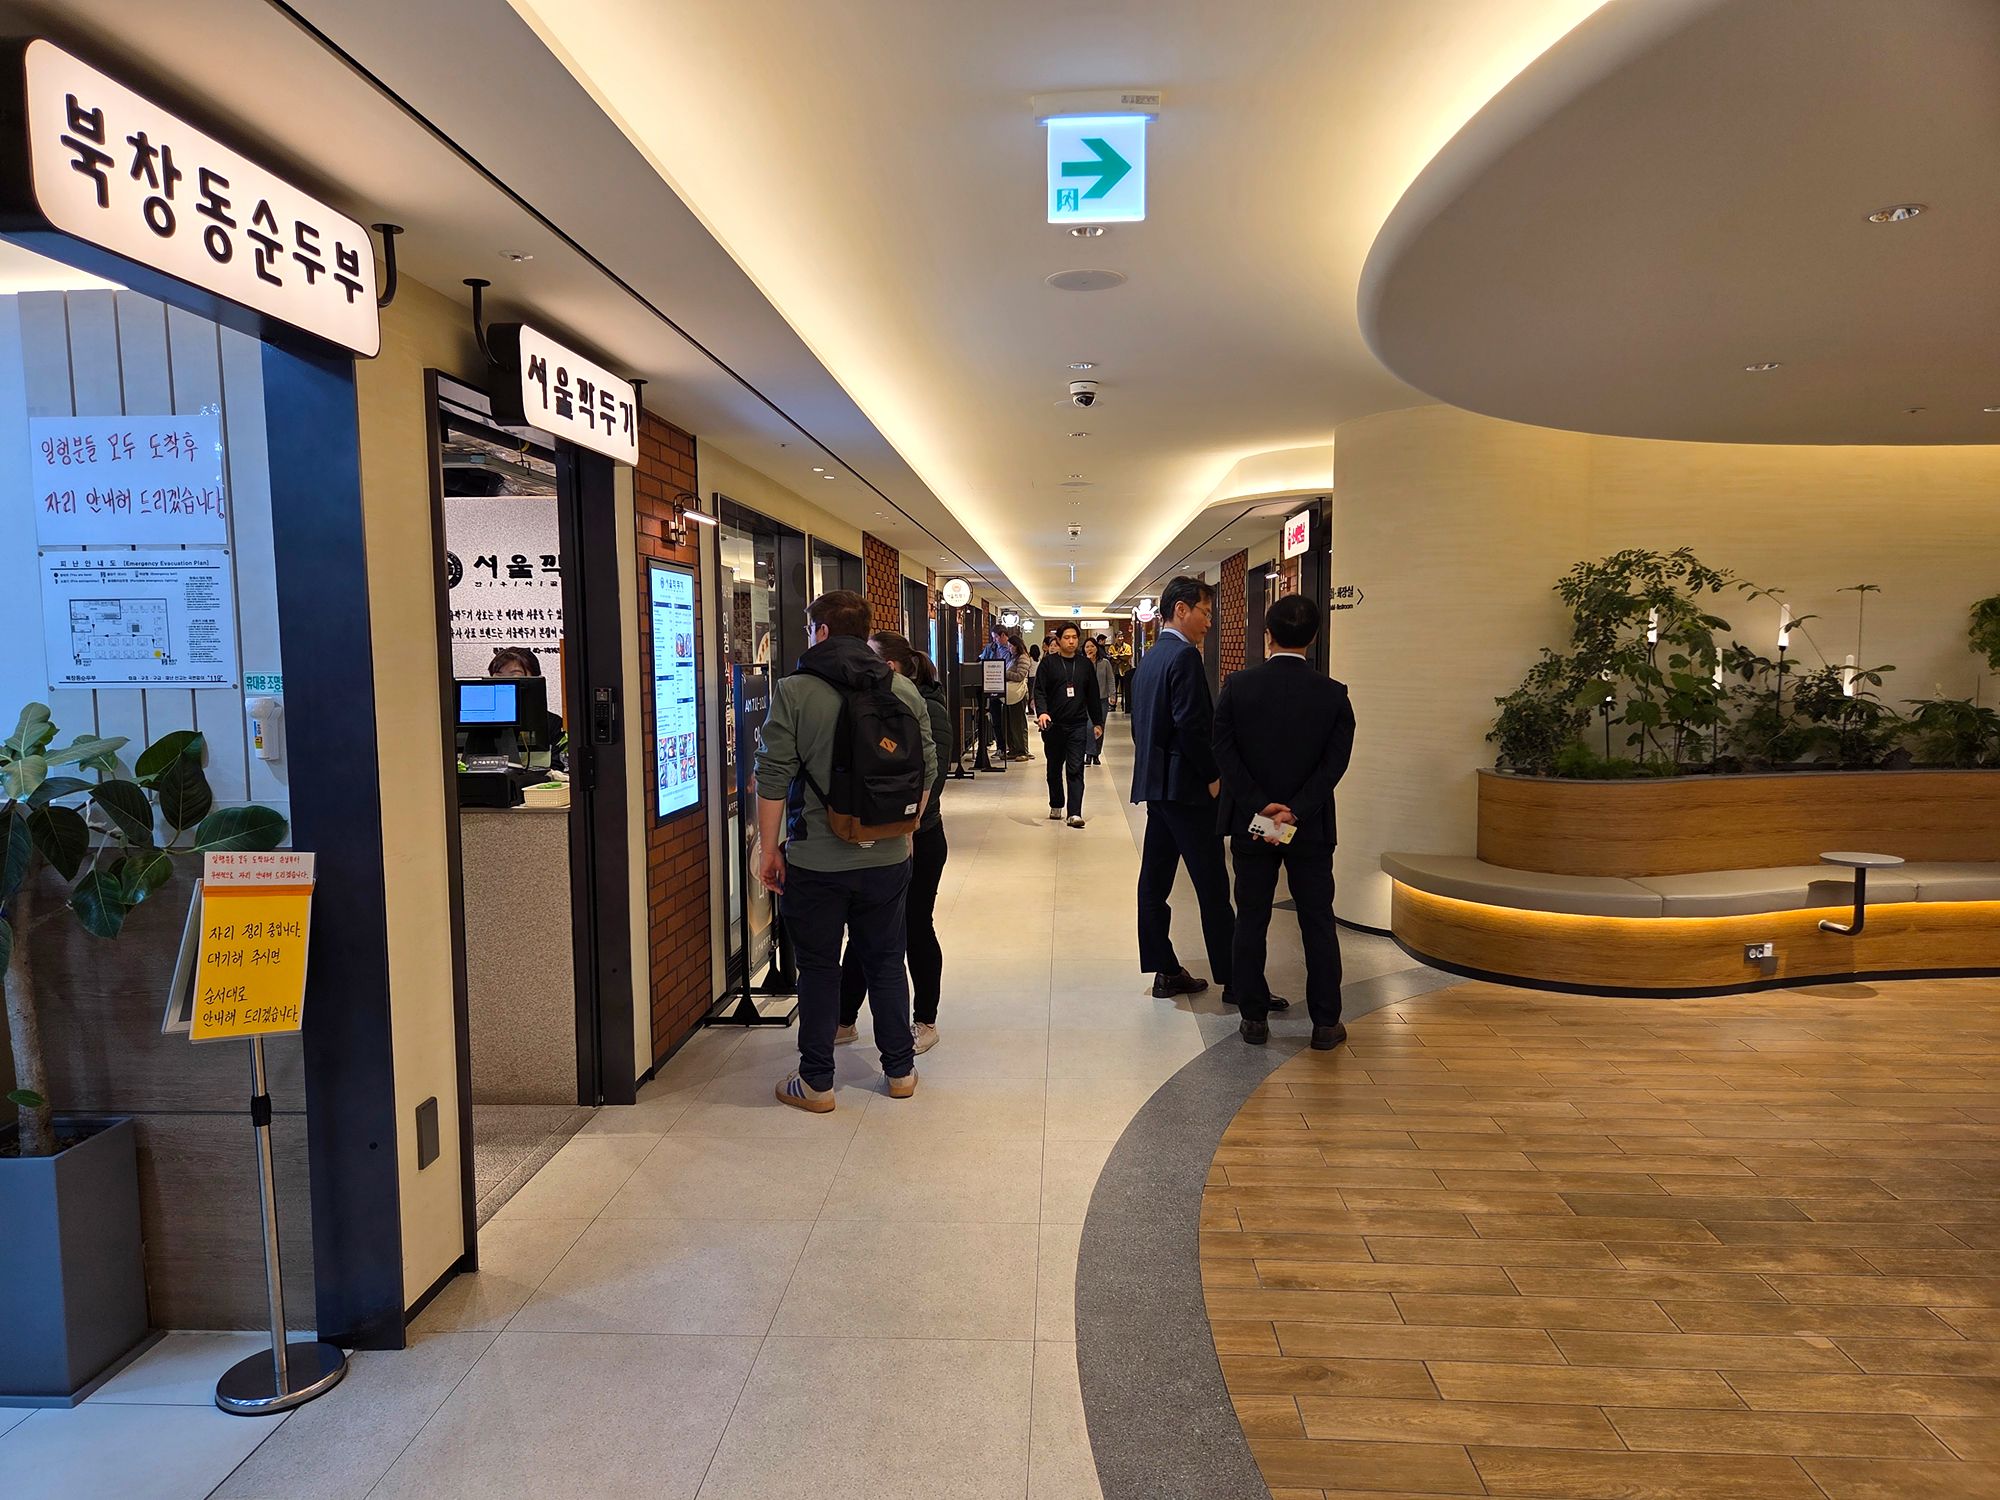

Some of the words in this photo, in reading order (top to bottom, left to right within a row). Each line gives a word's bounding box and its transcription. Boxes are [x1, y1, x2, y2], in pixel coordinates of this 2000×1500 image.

[60, 93, 364, 304] 북창동순두부
[527, 354, 635, 447] 서울깍두기
[41, 434, 97, 465] 일행분들
[108, 432, 135, 461] 모두
[150, 431, 199, 462] 도착후
[45, 489, 76, 514] 자리
[267, 675, 283, 690] 조명
[208, 925, 234, 940] 자리
[241, 922, 263, 939] 정리
[207, 949, 244, 967] 대기해
[251, 948, 280, 966] 주시면
[204, 985, 248, 1005] 순서대로
[203, 1008, 236, 1027] 안내해
